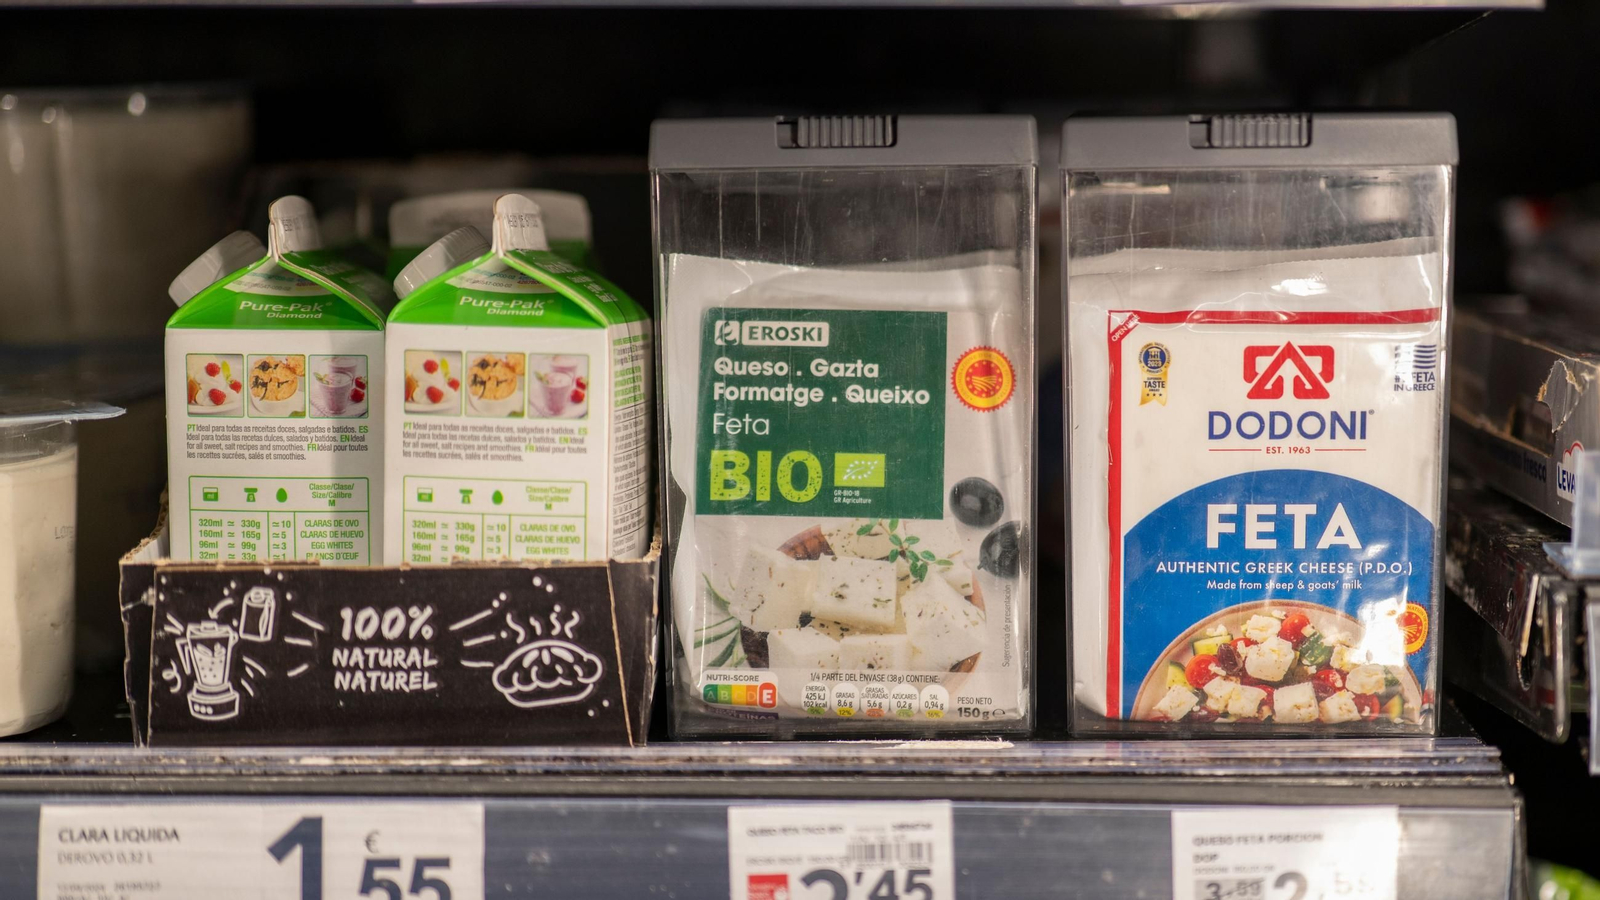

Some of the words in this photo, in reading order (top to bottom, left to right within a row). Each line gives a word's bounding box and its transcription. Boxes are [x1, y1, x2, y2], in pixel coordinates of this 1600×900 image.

[748, 326, 822, 341] EROSKI
[1112, 325, 1128, 341] OPEN
[714, 357, 788, 376] Queso
[810, 359, 878, 378] Gazta
[1406, 383, 1435, 391] GREECE
[714, 383, 823, 407] Formatge
[846, 384, 930, 404] Queixo
[187, 424, 196, 432] PT
[332, 426, 356, 434] batidos.
[359, 426, 368, 434] ES
[713, 413, 769, 435] Feta
[340, 434, 350, 442] EN
[237, 443, 258, 451] recipes
[710, 450, 822, 502] BIO
[241, 520, 260, 529] 330g
[282, 520, 291, 528] 10
[305, 519, 332, 527] CLARAS
[334, 519, 343, 527] DE
[345, 519, 359, 527] OVO
[1207, 503, 1362, 549] FETA
[199, 530, 222, 538] 160ml
[242, 531, 260, 540] 165g
[281, 531, 286, 539] 5
[241, 542, 256, 551] 99g
[281, 542, 286, 550] 3
[1156, 562, 1240, 574] AUTHENTIC
[1245, 562, 1293, 574] GREEK
[1298, 562, 1354, 574] CHEESE
[1359, 562, 1412, 576] (P.D.O.)
[1206, 580, 1236, 590] Made
[1240, 580, 1262, 590] from
[1265, 580, 1293, 592] sheep
[1298, 580, 1305, 590] &
[1342, 580, 1362, 590] milk
[341, 605, 434, 641] 100%
[332, 646, 438, 670] NATURAL
[334, 670, 438, 693] NATUREL
[706, 674, 759, 682] NUTRI-SCORE
[810, 673, 820, 681] 1/4
[822, 673, 843, 681] PARTE
[845, 673, 858, 681] DEL
[860, 674, 885, 682] ENVASE
[906, 675, 940, 683] CONTIENE:
[763, 689, 773, 704] E
[838, 700, 848, 708] 8,6
[867, 700, 877, 708] 5,6
[897, 701, 907, 709] 0,2
[925, 701, 938, 709] 0,94
[958, 707, 980, 718] 150
[982, 710, 990, 720] g
[58, 828, 109, 842] CLARA
[114, 828, 180, 843] LIQUIDA
[366, 830, 380, 854] €
[268, 816, 322, 900] 1
